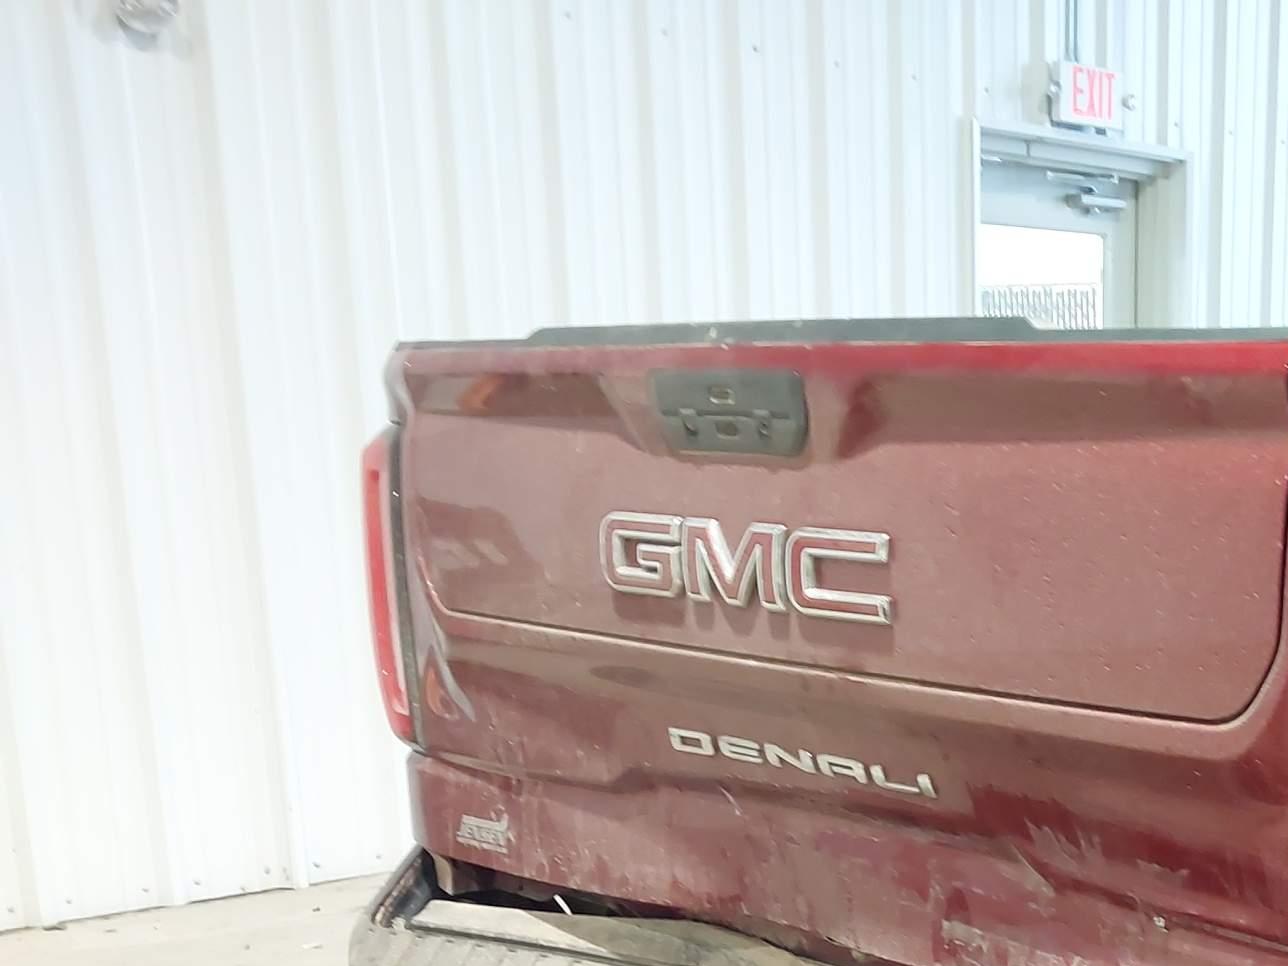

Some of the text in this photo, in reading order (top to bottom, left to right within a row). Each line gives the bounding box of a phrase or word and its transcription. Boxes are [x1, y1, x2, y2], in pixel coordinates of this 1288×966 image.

[1073, 65, 1115, 120] EXIT
[600, 511, 891, 625] GMC
[668, 726, 938, 799] DENALI
